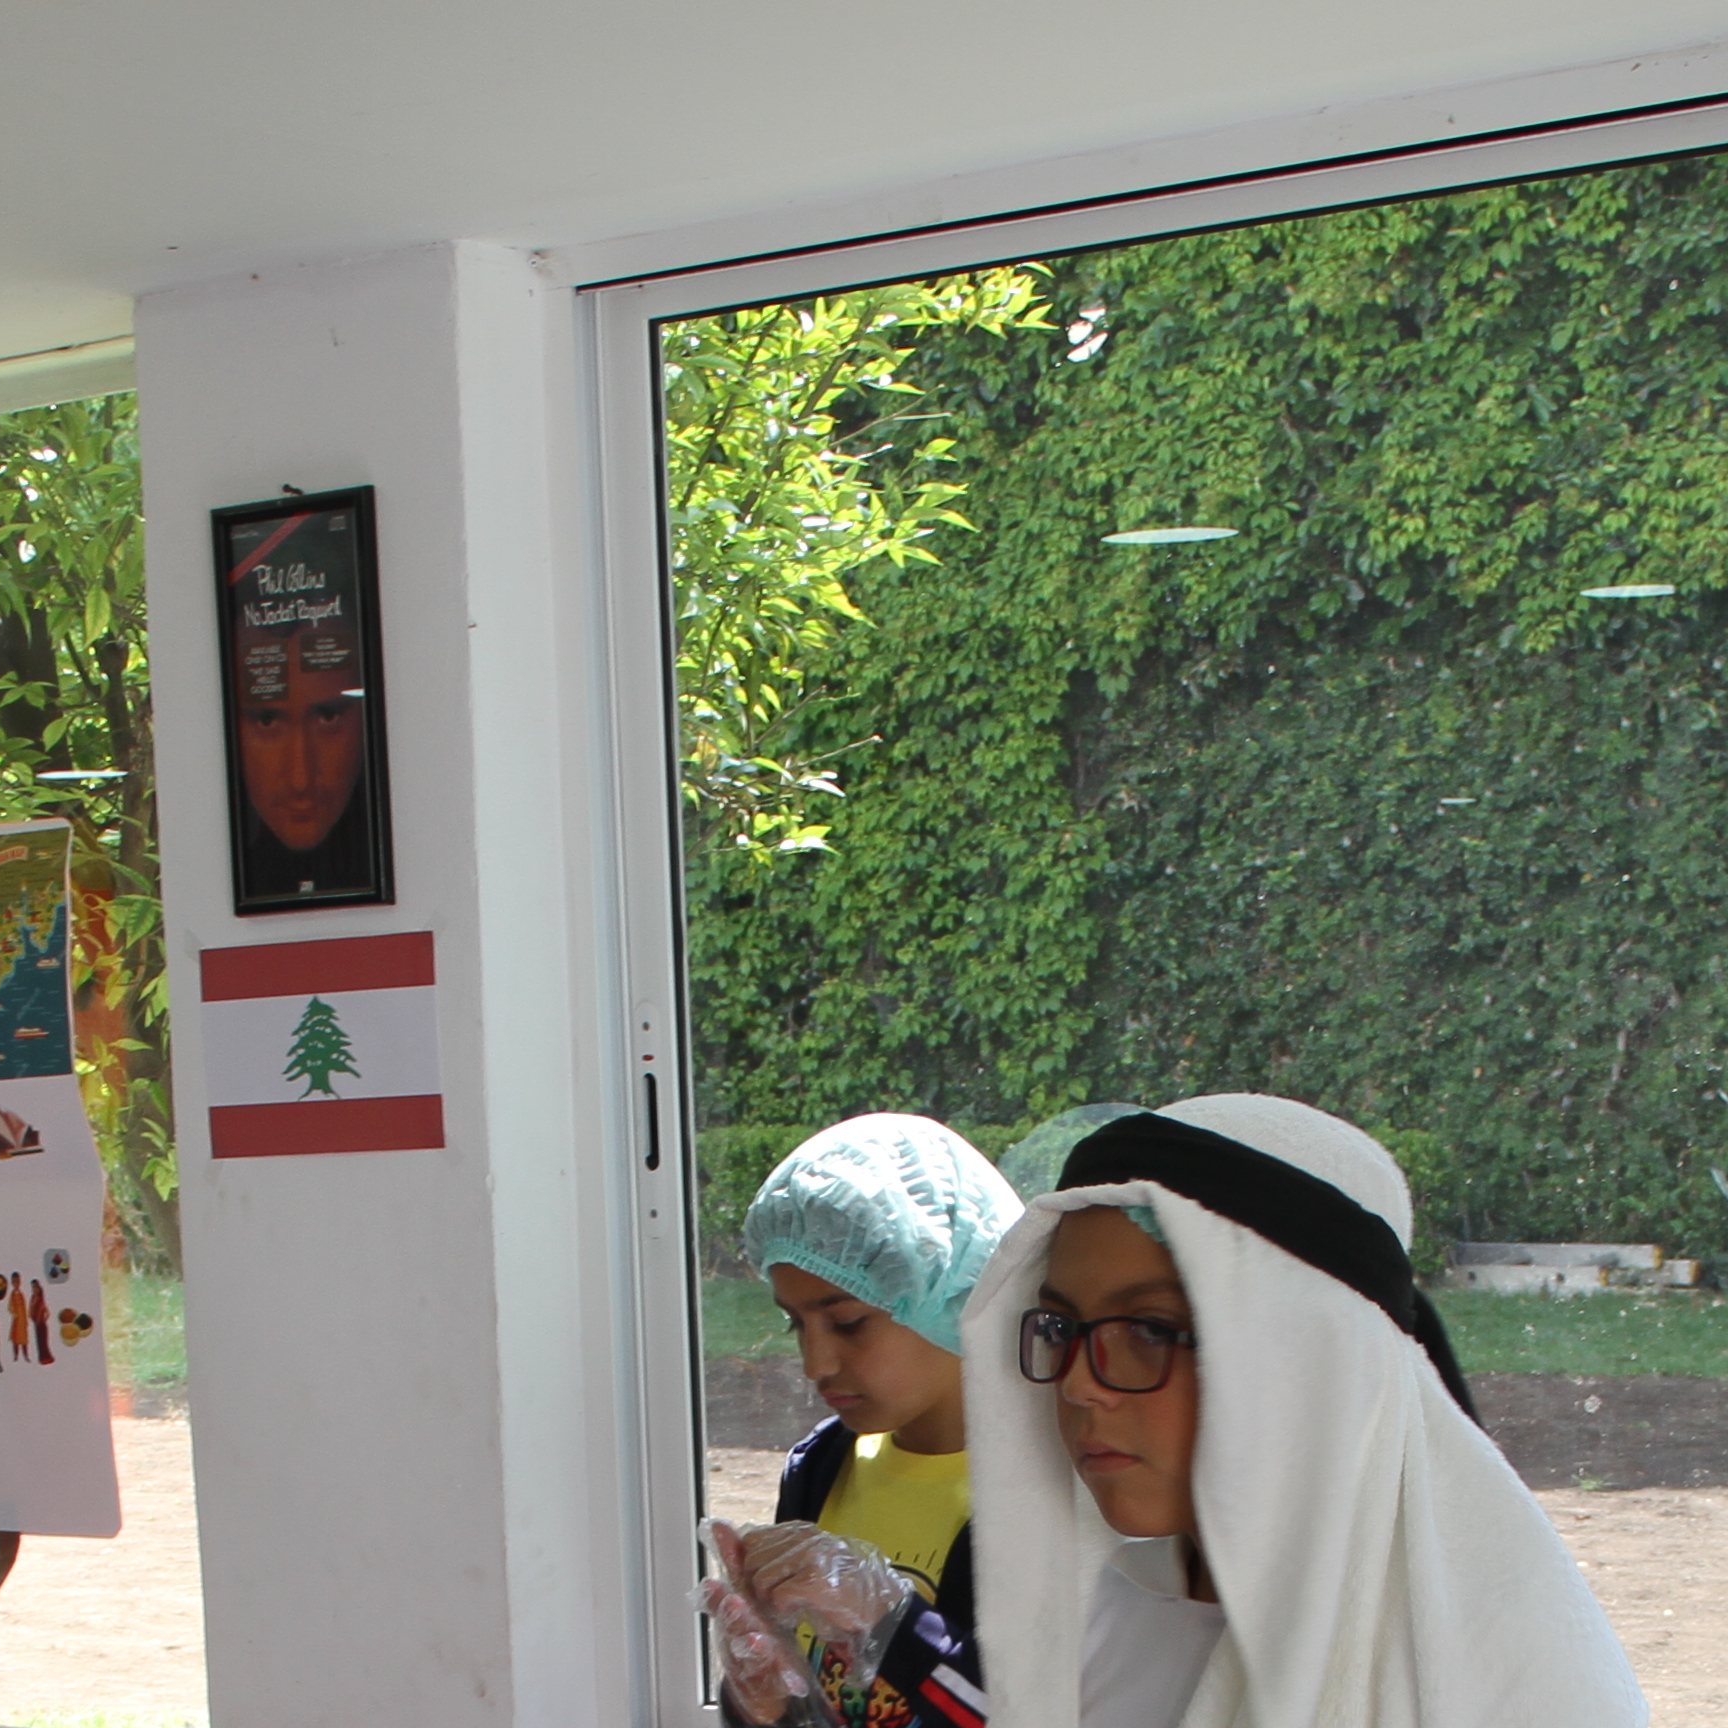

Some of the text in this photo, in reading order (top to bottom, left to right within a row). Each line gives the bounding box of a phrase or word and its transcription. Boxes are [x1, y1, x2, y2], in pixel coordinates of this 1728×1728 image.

[252, 562, 326, 596] Phil Collins
[244, 595, 342, 628] No Jacket Required
